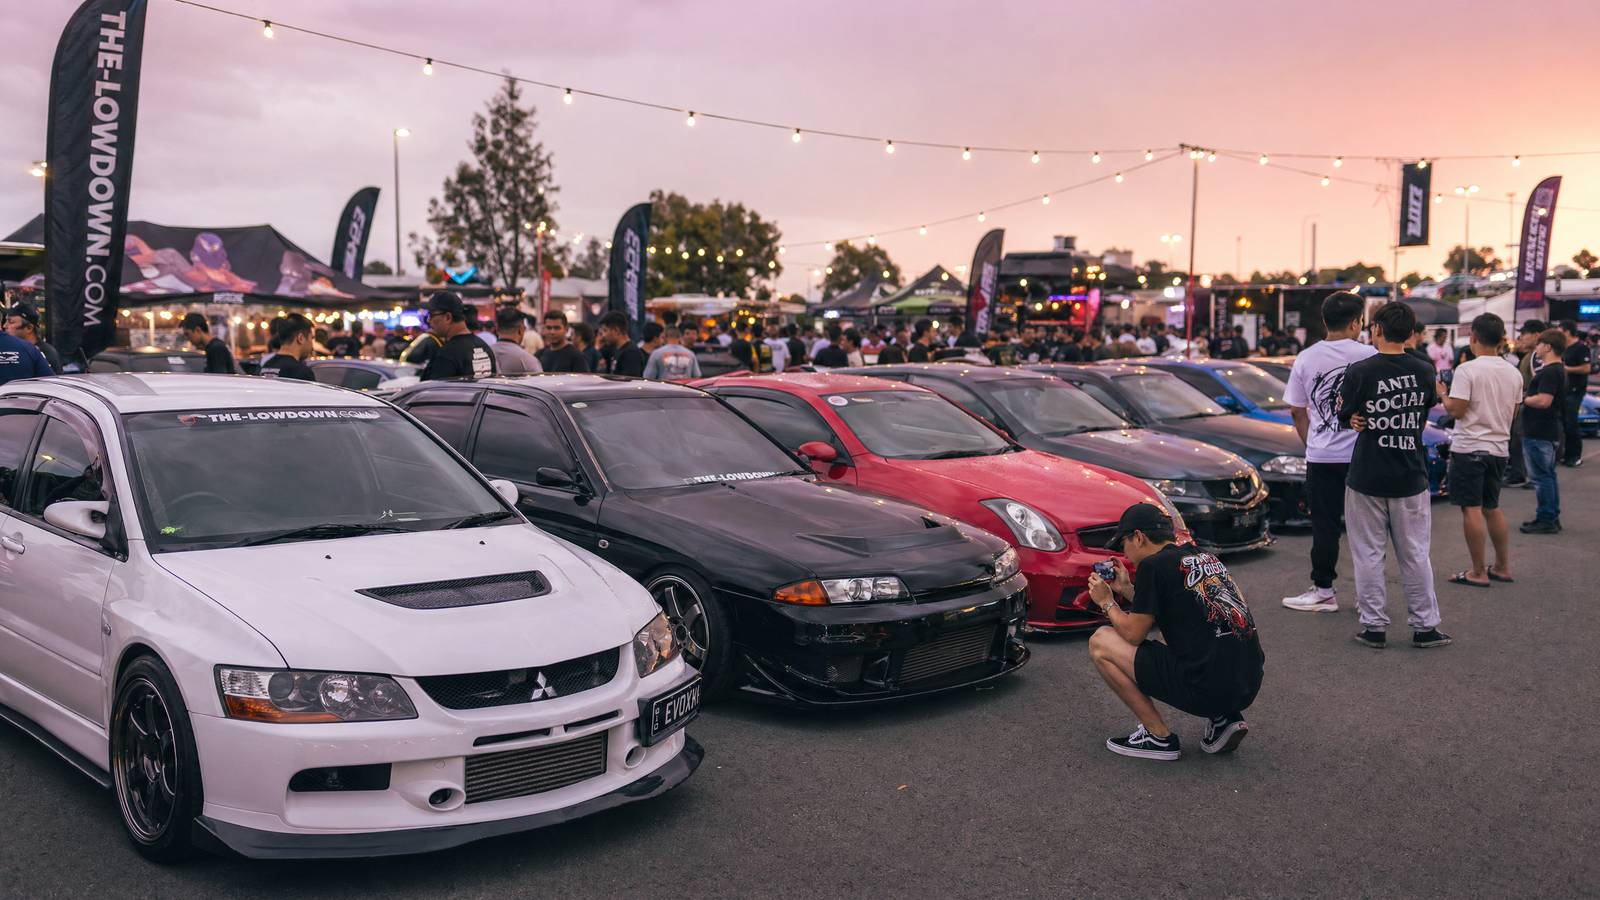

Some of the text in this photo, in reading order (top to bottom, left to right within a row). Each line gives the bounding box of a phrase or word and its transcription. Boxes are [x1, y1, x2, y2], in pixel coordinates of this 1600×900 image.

[83, 11, 127, 327] THE-LOWDOWN.COM
[1377, 375, 1418, 394] ANTI
[1366, 392, 1425, 413] SOCIAL
[1378, 435, 1416, 450] CLUB
